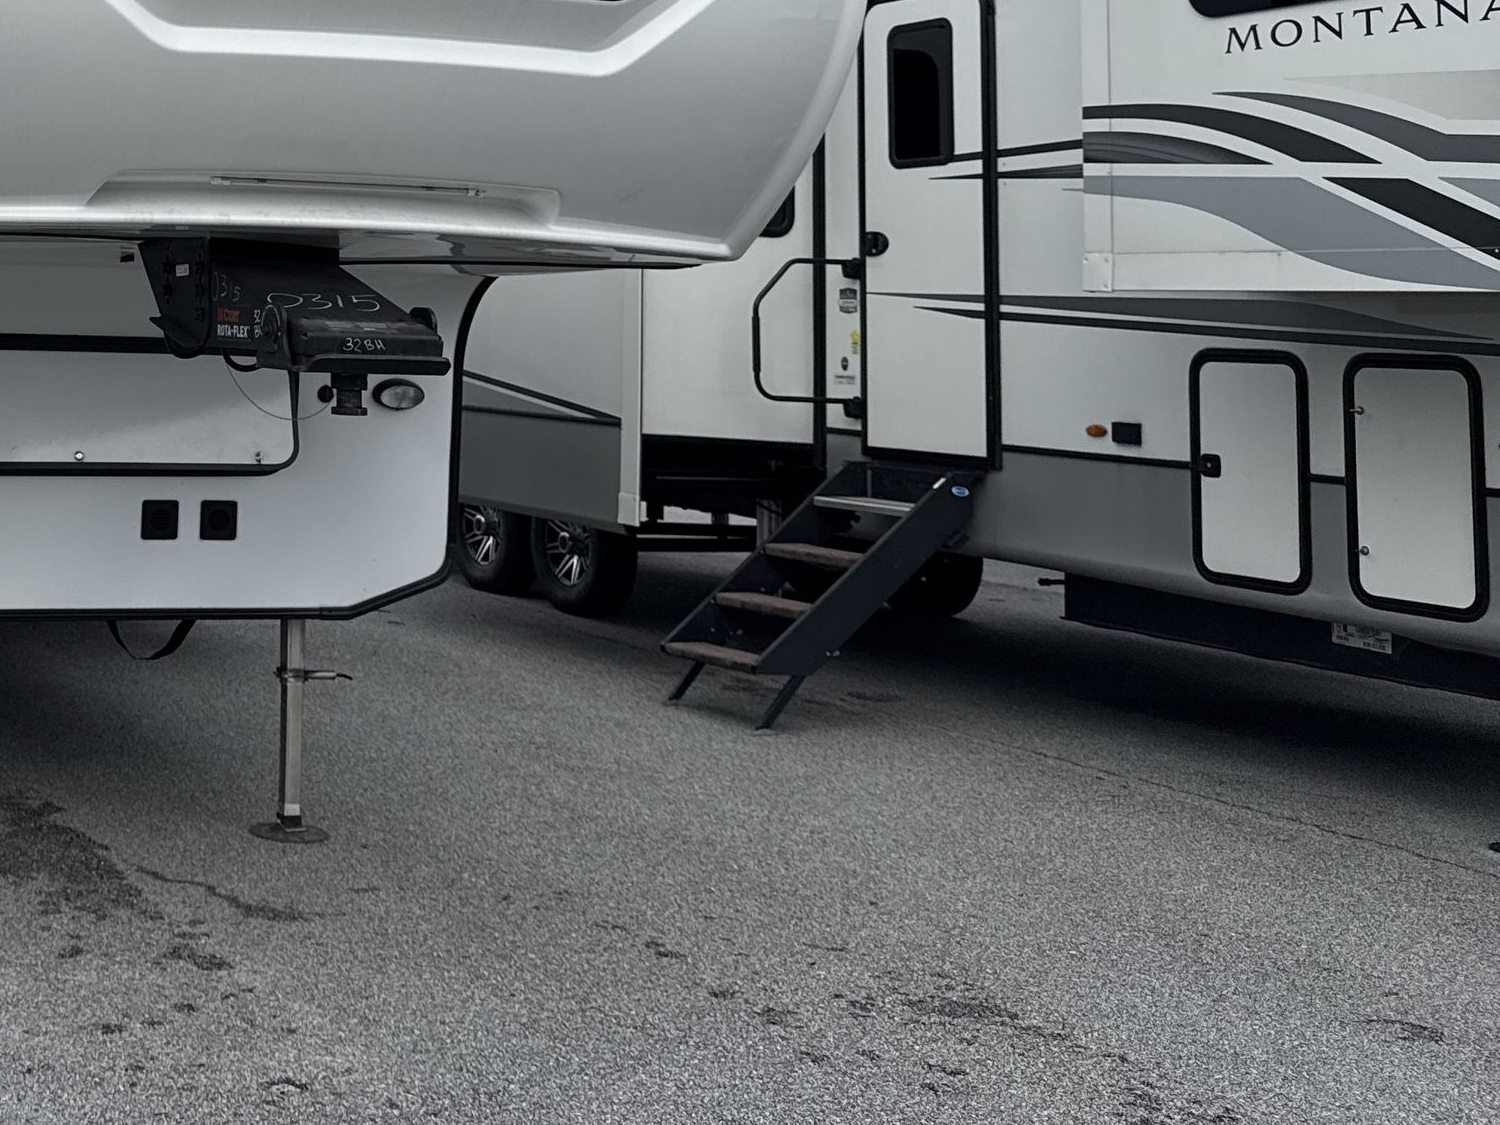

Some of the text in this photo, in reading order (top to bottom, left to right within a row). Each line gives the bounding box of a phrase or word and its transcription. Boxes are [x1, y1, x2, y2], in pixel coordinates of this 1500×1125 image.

[211, 271, 242, 302] 0315
[266, 292, 381, 312] 0315
[217, 324, 248, 338] ROTA-FLEX
